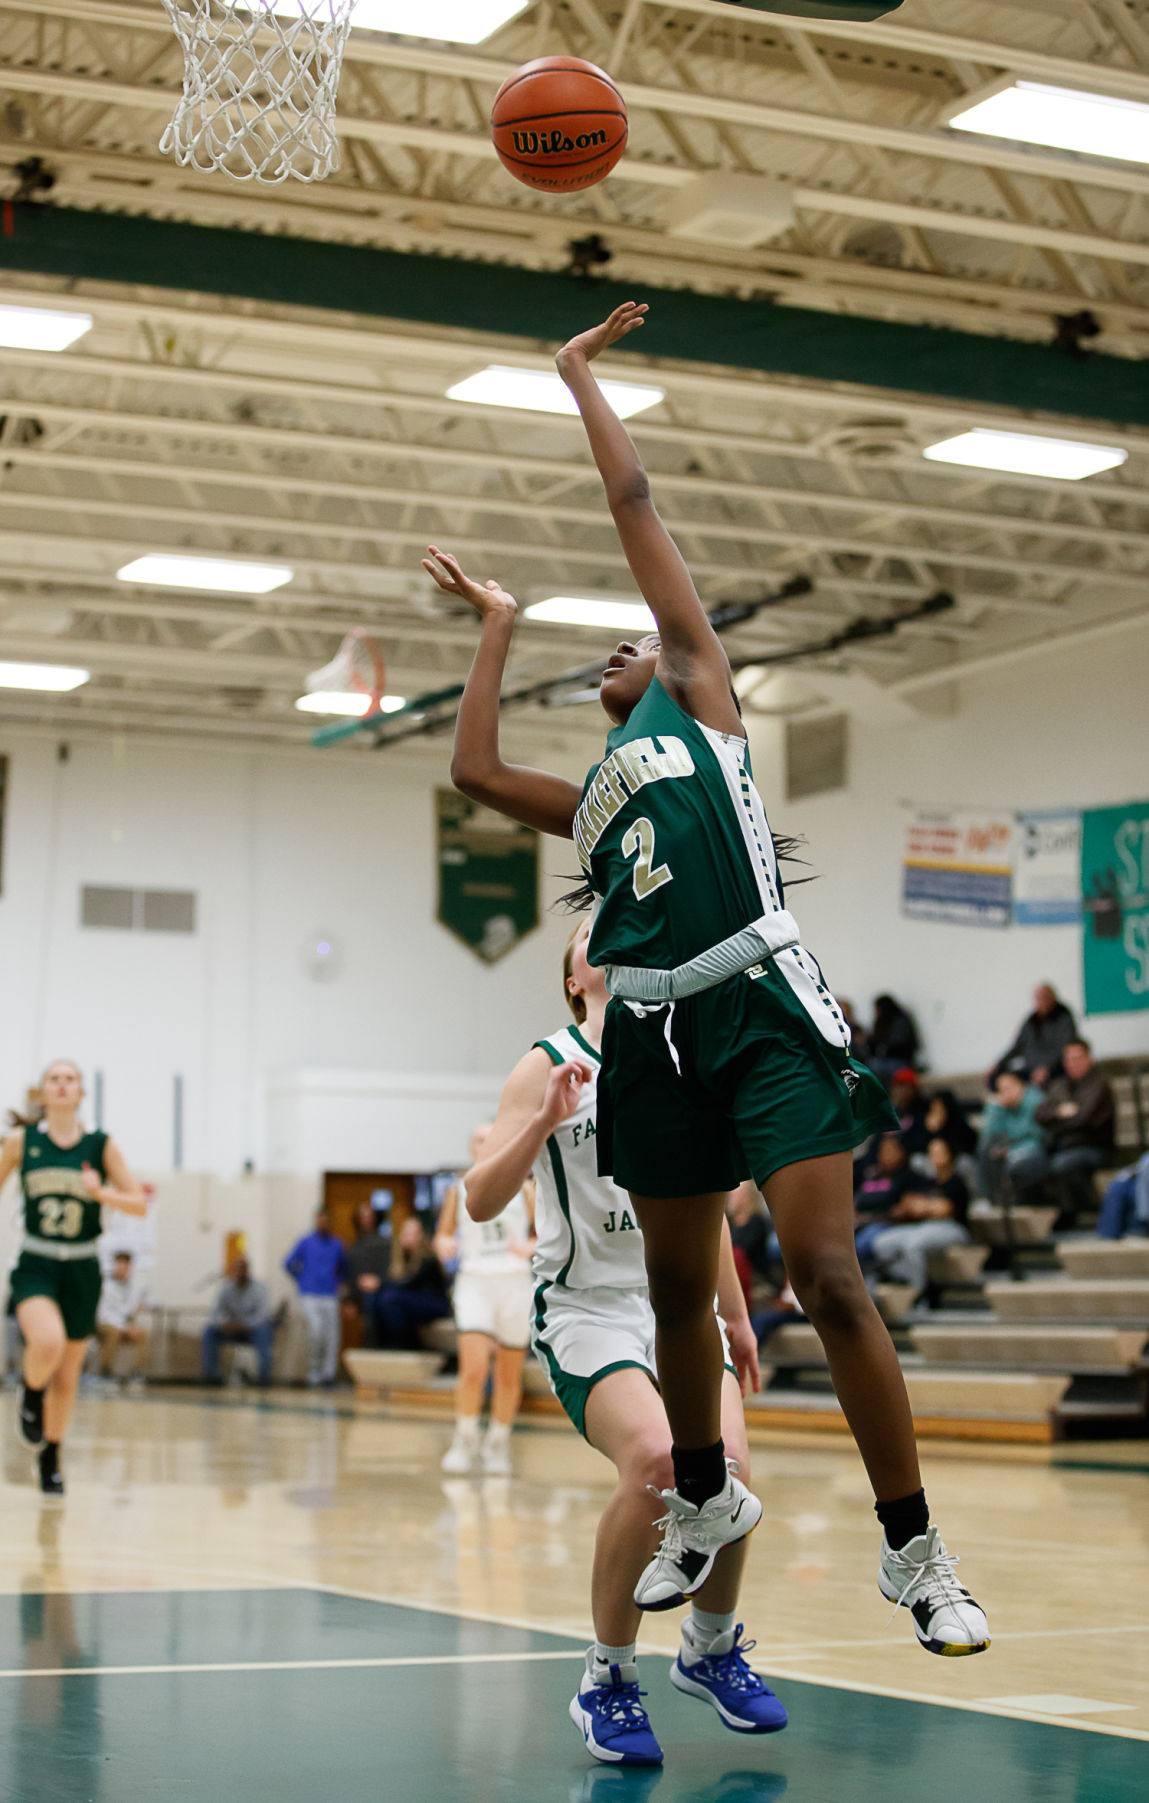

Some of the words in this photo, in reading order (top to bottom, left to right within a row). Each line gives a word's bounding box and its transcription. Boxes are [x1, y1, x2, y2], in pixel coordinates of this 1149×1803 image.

[511, 129, 607, 154] Wilson
[621, 816, 674, 902] 2
[572, 1117, 597, 1147] FA
[603, 1209, 641, 1233] JA
